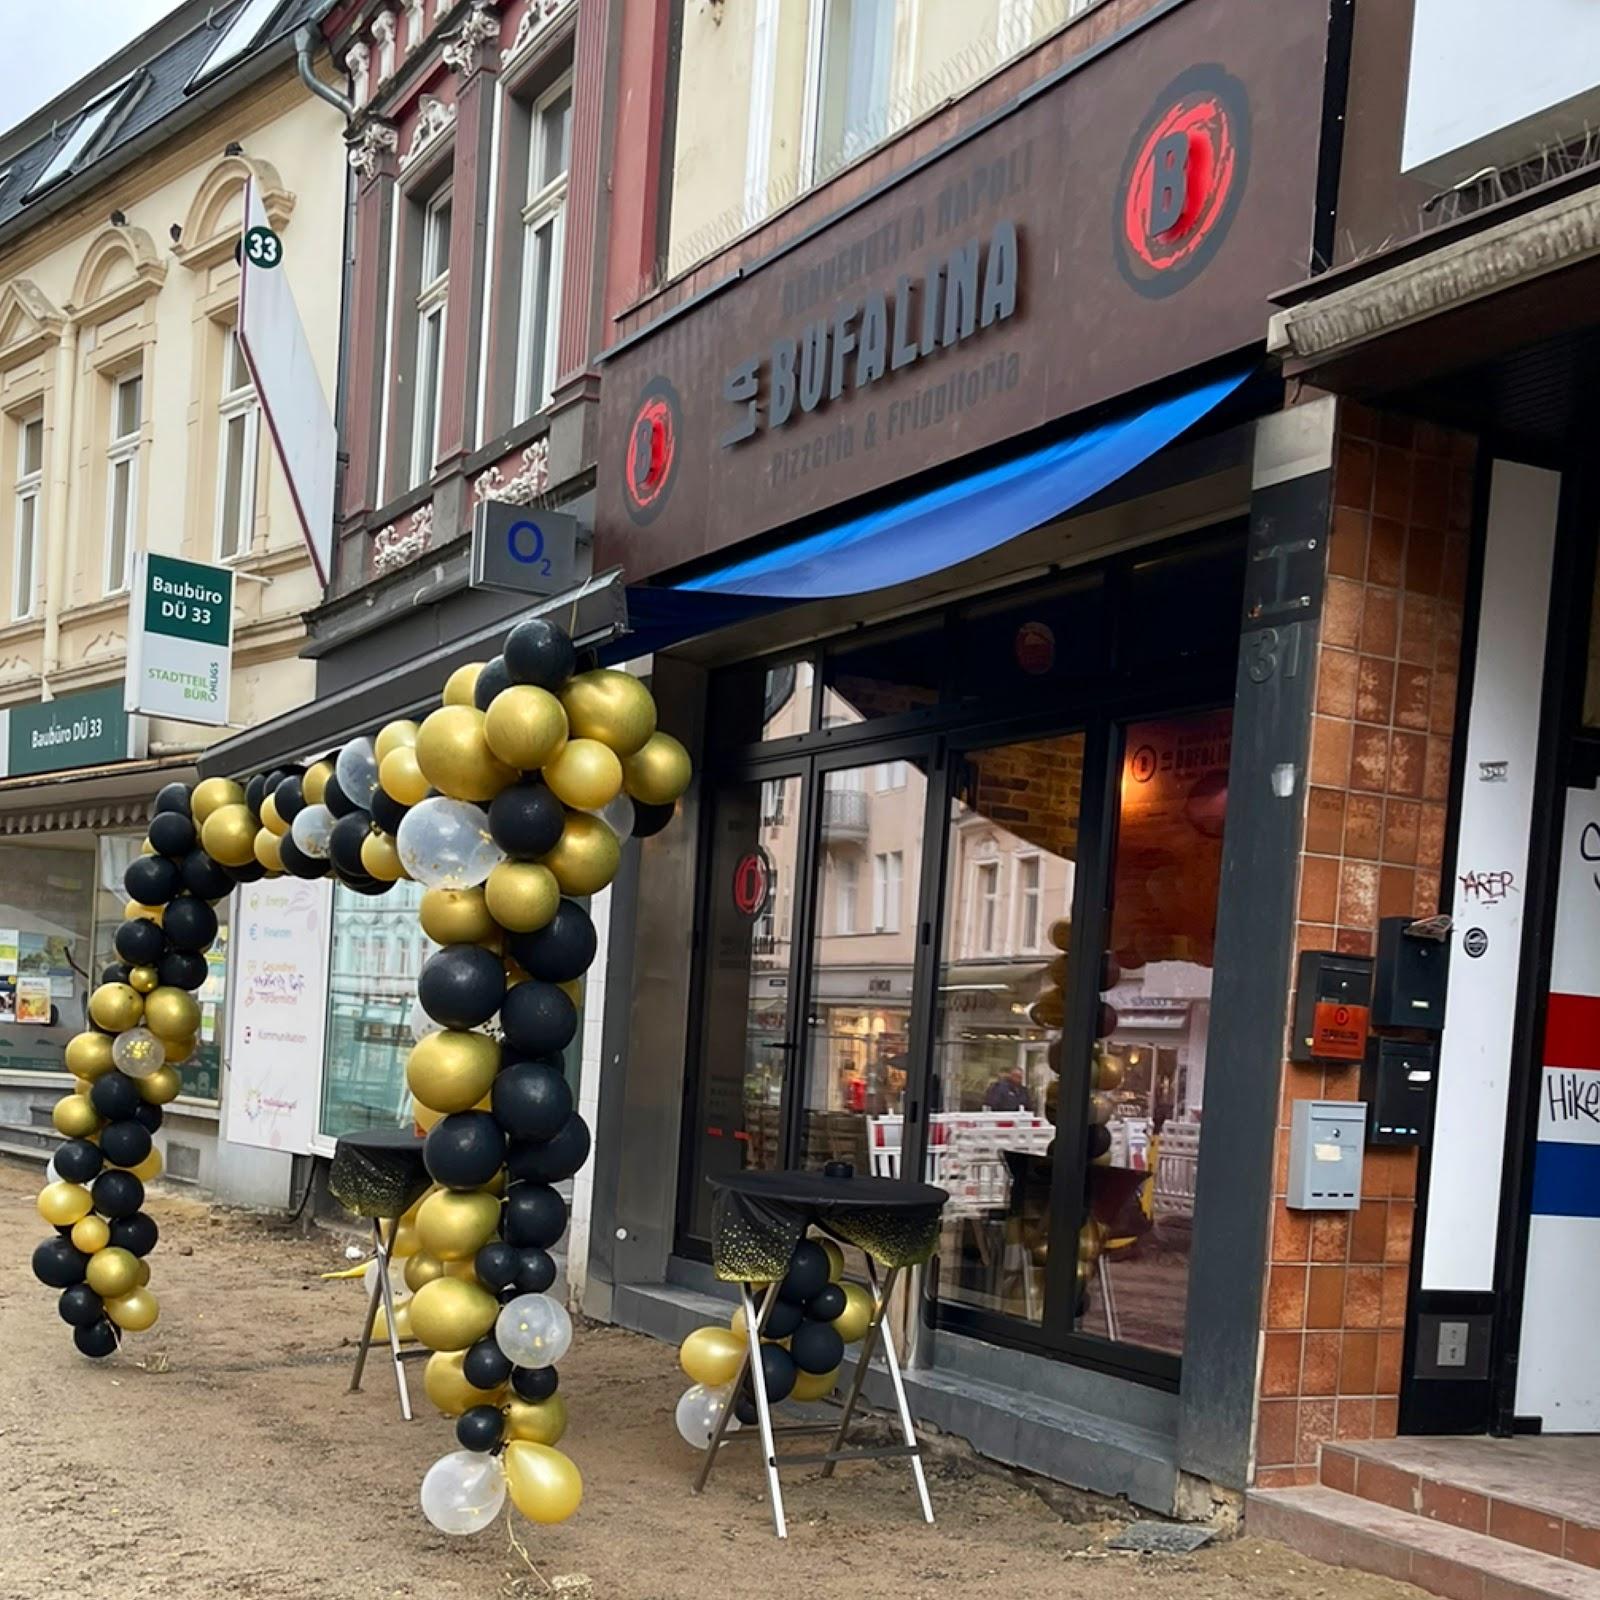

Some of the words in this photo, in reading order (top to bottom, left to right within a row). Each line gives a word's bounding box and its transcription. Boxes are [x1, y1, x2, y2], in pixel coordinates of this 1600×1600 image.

[911, 205, 925, 251] A
[937, 140, 1034, 236] NAPOLI
[249, 233, 277, 262] 33
[769, 218, 1022, 429] BUFALINA
[888, 351, 1021, 441] Friggitoria
[152, 576, 223, 605] Baubüro
[161, 601, 187, 619] DÜ
[191, 607, 211, 624] 33
[1249, 622, 1302, 685] 31
[148, 668, 208, 689] STADTTEIL
[32, 725, 71, 749] Baubüro
[72, 716, 88, 741] DÜ
[89, 717, 103, 739] 33
[1547, 1073, 1600, 1122] Hike
